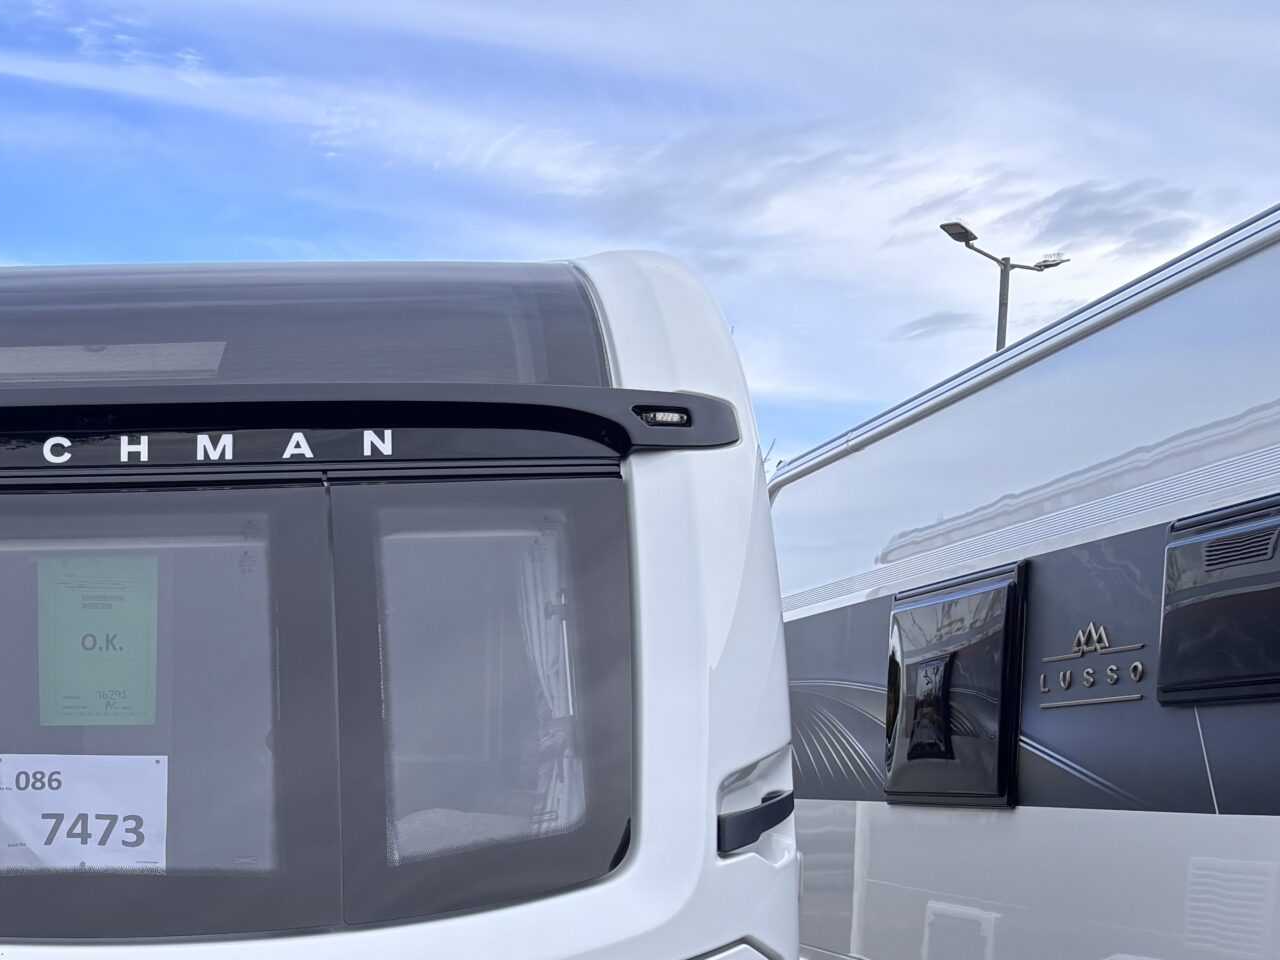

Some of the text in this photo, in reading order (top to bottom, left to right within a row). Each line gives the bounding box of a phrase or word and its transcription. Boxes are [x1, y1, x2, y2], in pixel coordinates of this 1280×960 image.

[81, 633, 124, 651] O.K.
[1039, 661, 1145, 693] LUSSO
[15, 771, 63, 791] 086
[41, 813, 146, 848] 7473
